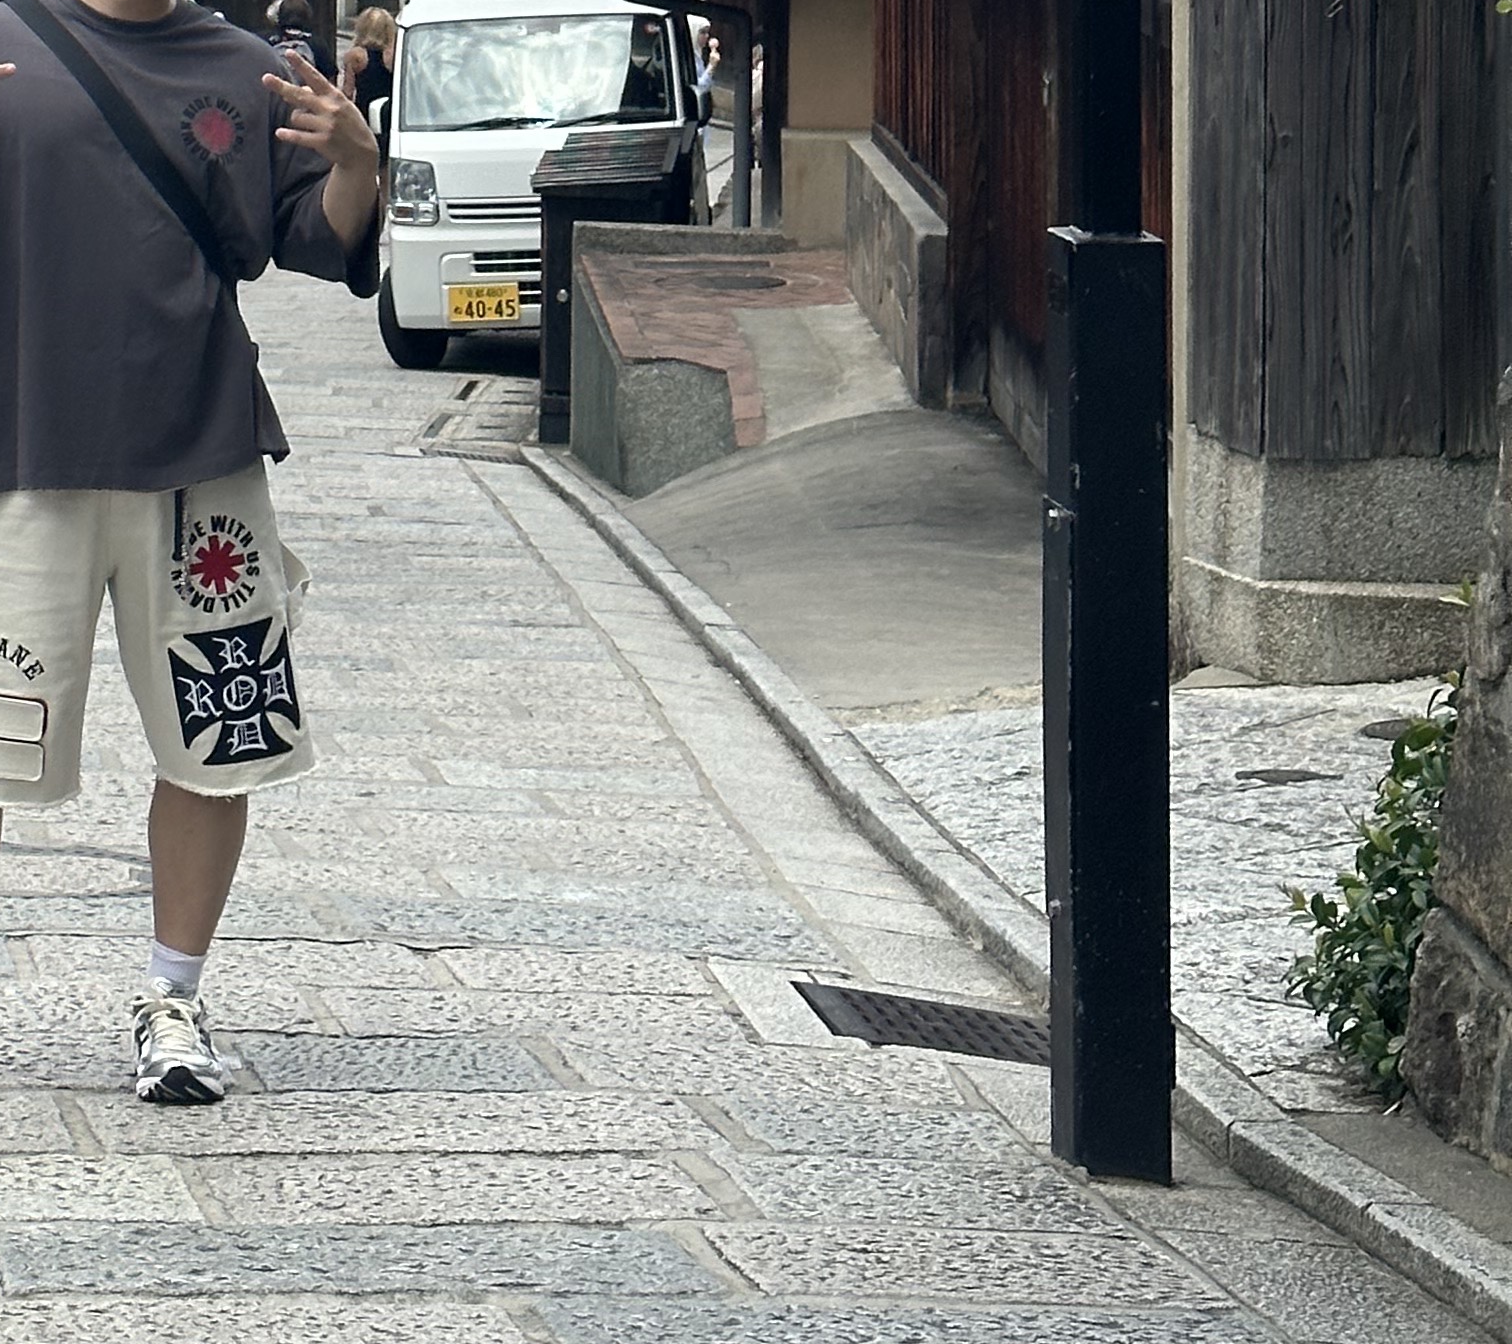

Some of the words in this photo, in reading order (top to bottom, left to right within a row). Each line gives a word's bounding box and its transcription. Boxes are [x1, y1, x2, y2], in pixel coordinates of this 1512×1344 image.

[465, 299, 516, 319] 40-45
[210, 515, 254, 548] WITH
[245, 550, 260, 576] US
[220, 581, 256, 613] TILL
